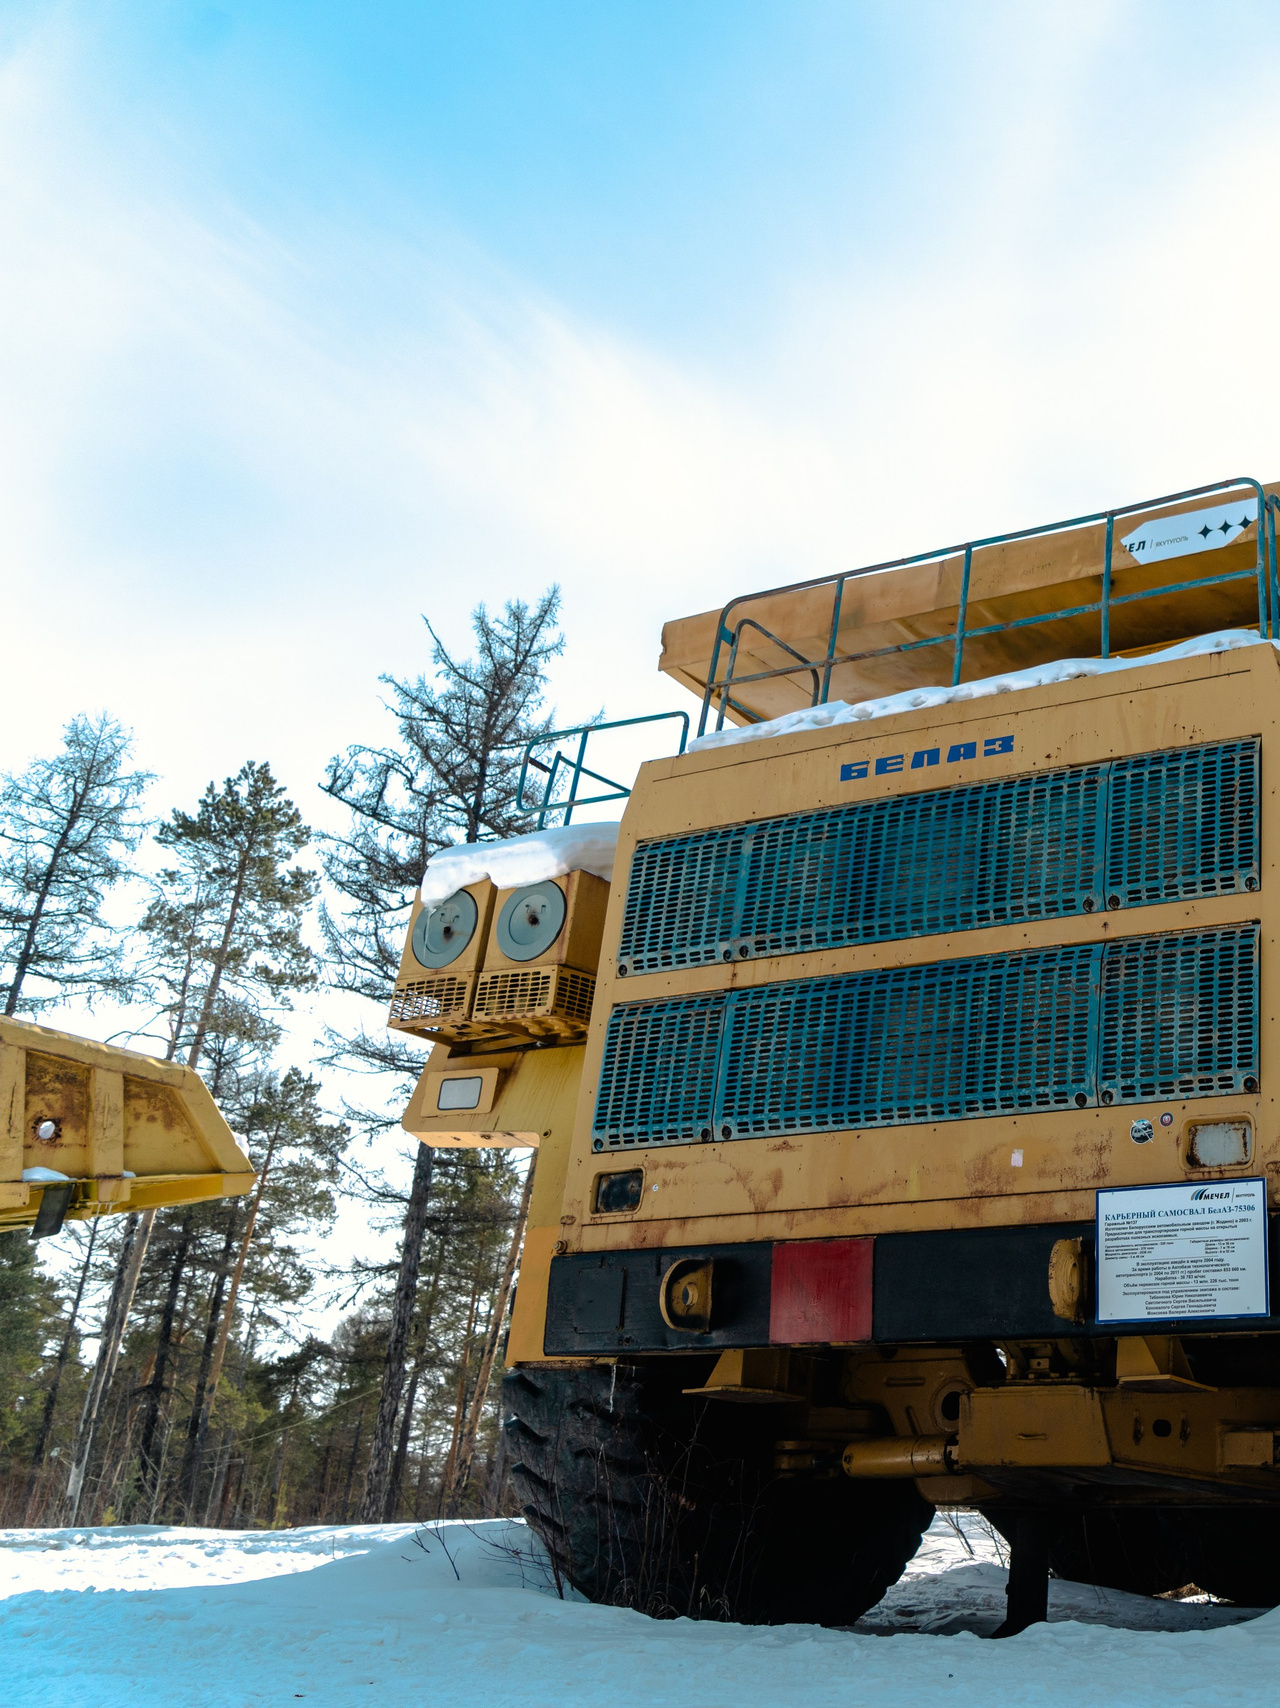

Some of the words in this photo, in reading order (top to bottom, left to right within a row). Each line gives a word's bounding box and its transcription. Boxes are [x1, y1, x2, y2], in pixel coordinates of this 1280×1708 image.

[1123, 540, 1146, 553] ЕЛ
[1155, 535, 1189, 548] ЯКУТУГОЛЬ
[840, 735, 1015, 782] БЕЛАЗ
[1105, 1210, 1156, 1221] КАРЬЕРНЫЙ
[1158, 1208, 1205, 1218] САМОСВАЛ
[1208, 1205, 1256, 1214] БелАЗ-75306
